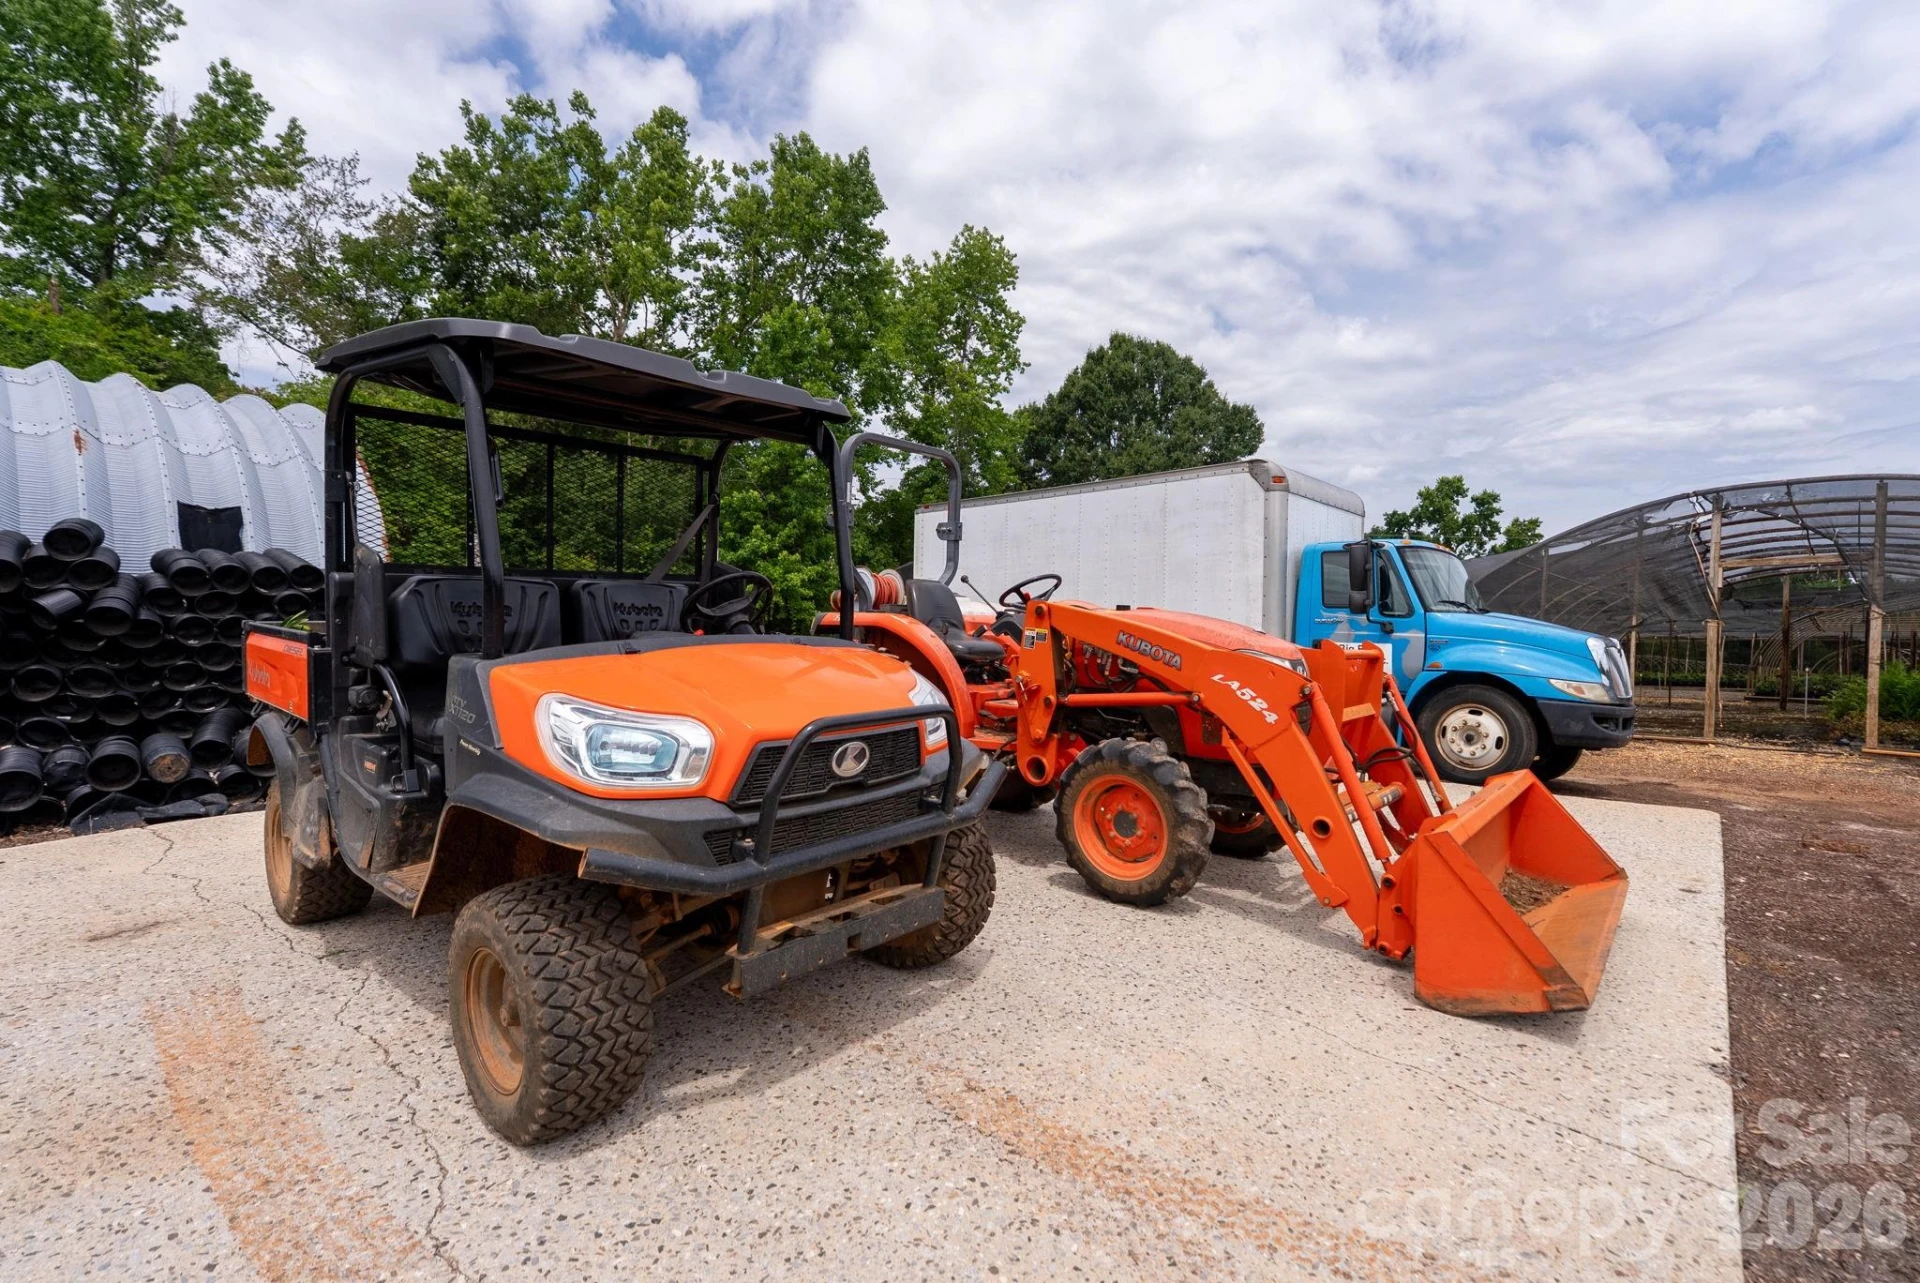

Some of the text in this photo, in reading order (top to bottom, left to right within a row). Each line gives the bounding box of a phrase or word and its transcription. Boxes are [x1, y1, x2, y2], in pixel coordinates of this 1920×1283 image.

[450, 601, 512, 617] Kuba
[613, 602, 663, 617] Kubota
[1116, 630, 1182, 671] KUBOTA
[1210, 673, 1279, 724] LA524
